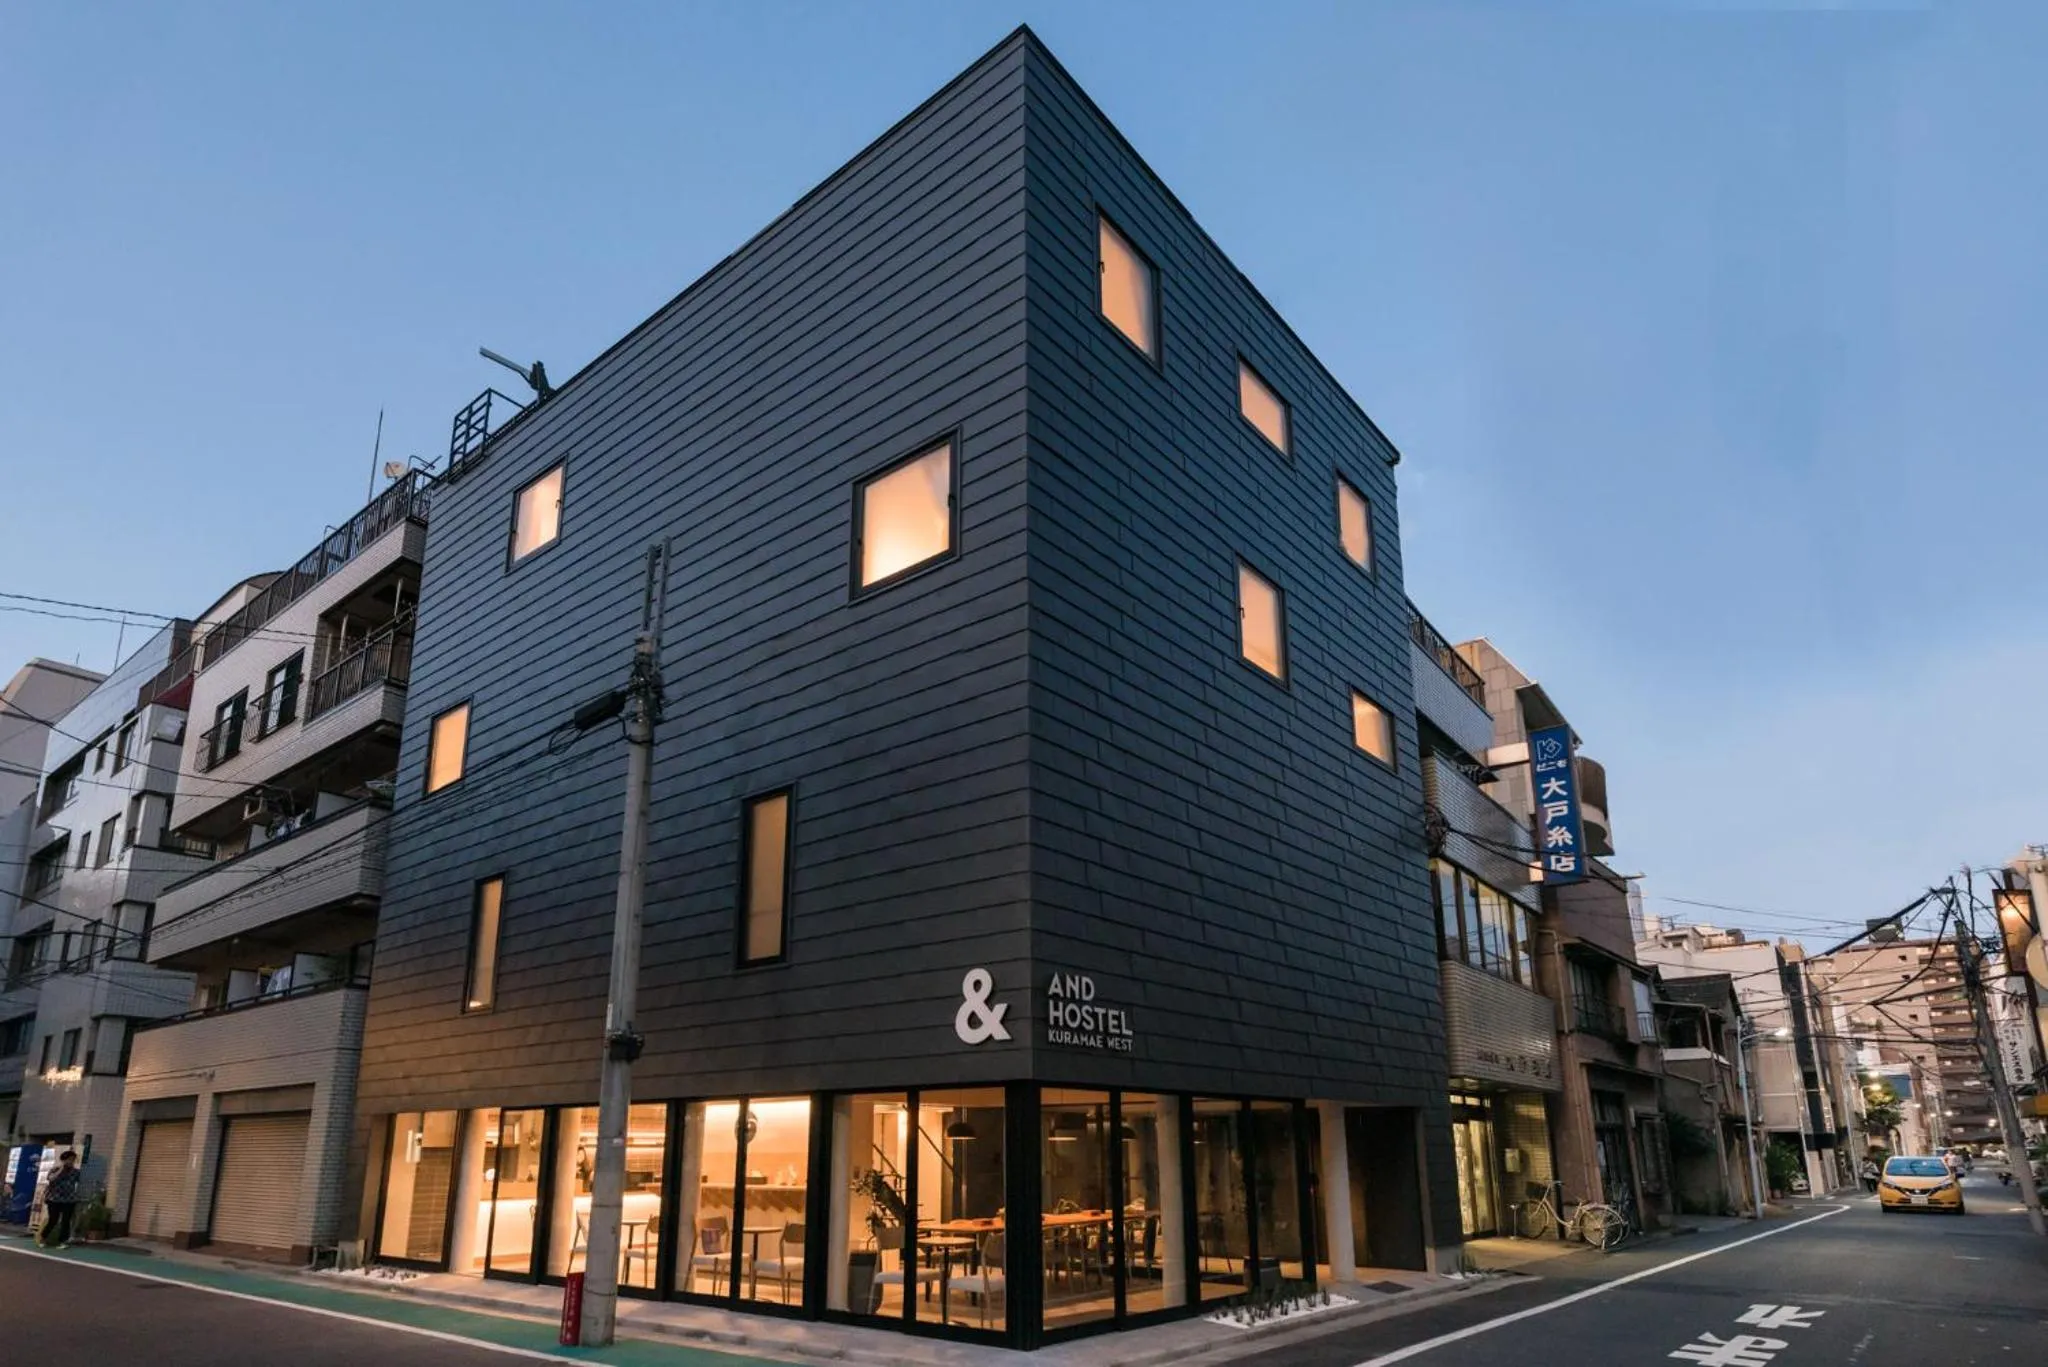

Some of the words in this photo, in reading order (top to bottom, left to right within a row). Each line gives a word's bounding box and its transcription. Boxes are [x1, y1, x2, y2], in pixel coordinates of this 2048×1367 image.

[1541, 776, 1576, 872] 大戸糸店
[1048, 972, 1095, 1001] AND
[955, 968, 1012, 1045] &
[1049, 999, 1133, 1036] HOSTEL
[1048, 1029, 1104, 1048] KURAMAE
[1107, 1036, 1133, 1052] WEST
